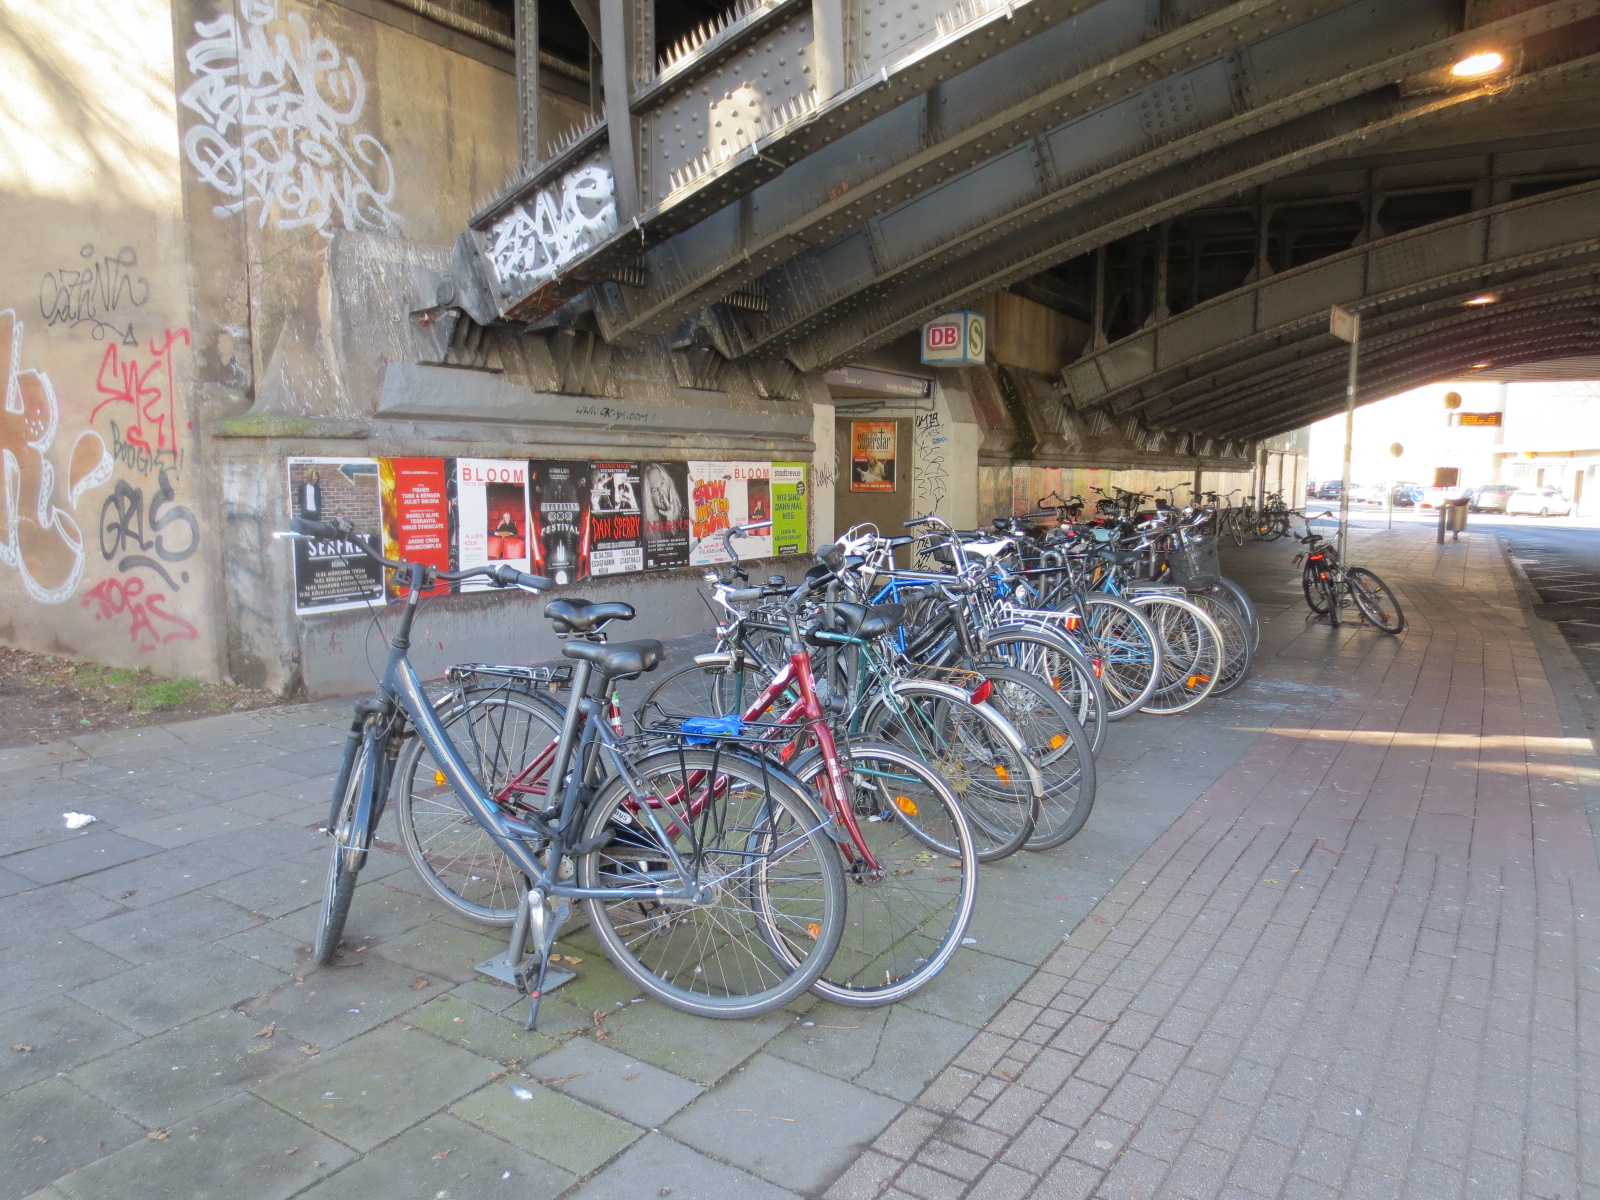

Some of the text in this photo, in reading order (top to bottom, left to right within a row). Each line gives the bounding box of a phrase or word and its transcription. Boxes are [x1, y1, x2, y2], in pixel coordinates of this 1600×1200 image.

[931, 328, 957, 345] DB
[969, 319, 984, 357] S
[923, 382, 929, 393] 2
[462, 467, 524, 483] BLOOM
[734, 468, 770, 480] BLOOM
[774, 469, 802, 477] stadtrevue
[693, 480, 727, 507] SHOW
[776, 493, 801, 502] WIR SIND
[775, 502, 803, 511] DANN MAL
[782, 511, 795, 520] WEG
[541, 523, 580, 537] FESTIVAL
[591, 516, 611, 542] DAN
[613, 514, 641, 540] SPERRY
